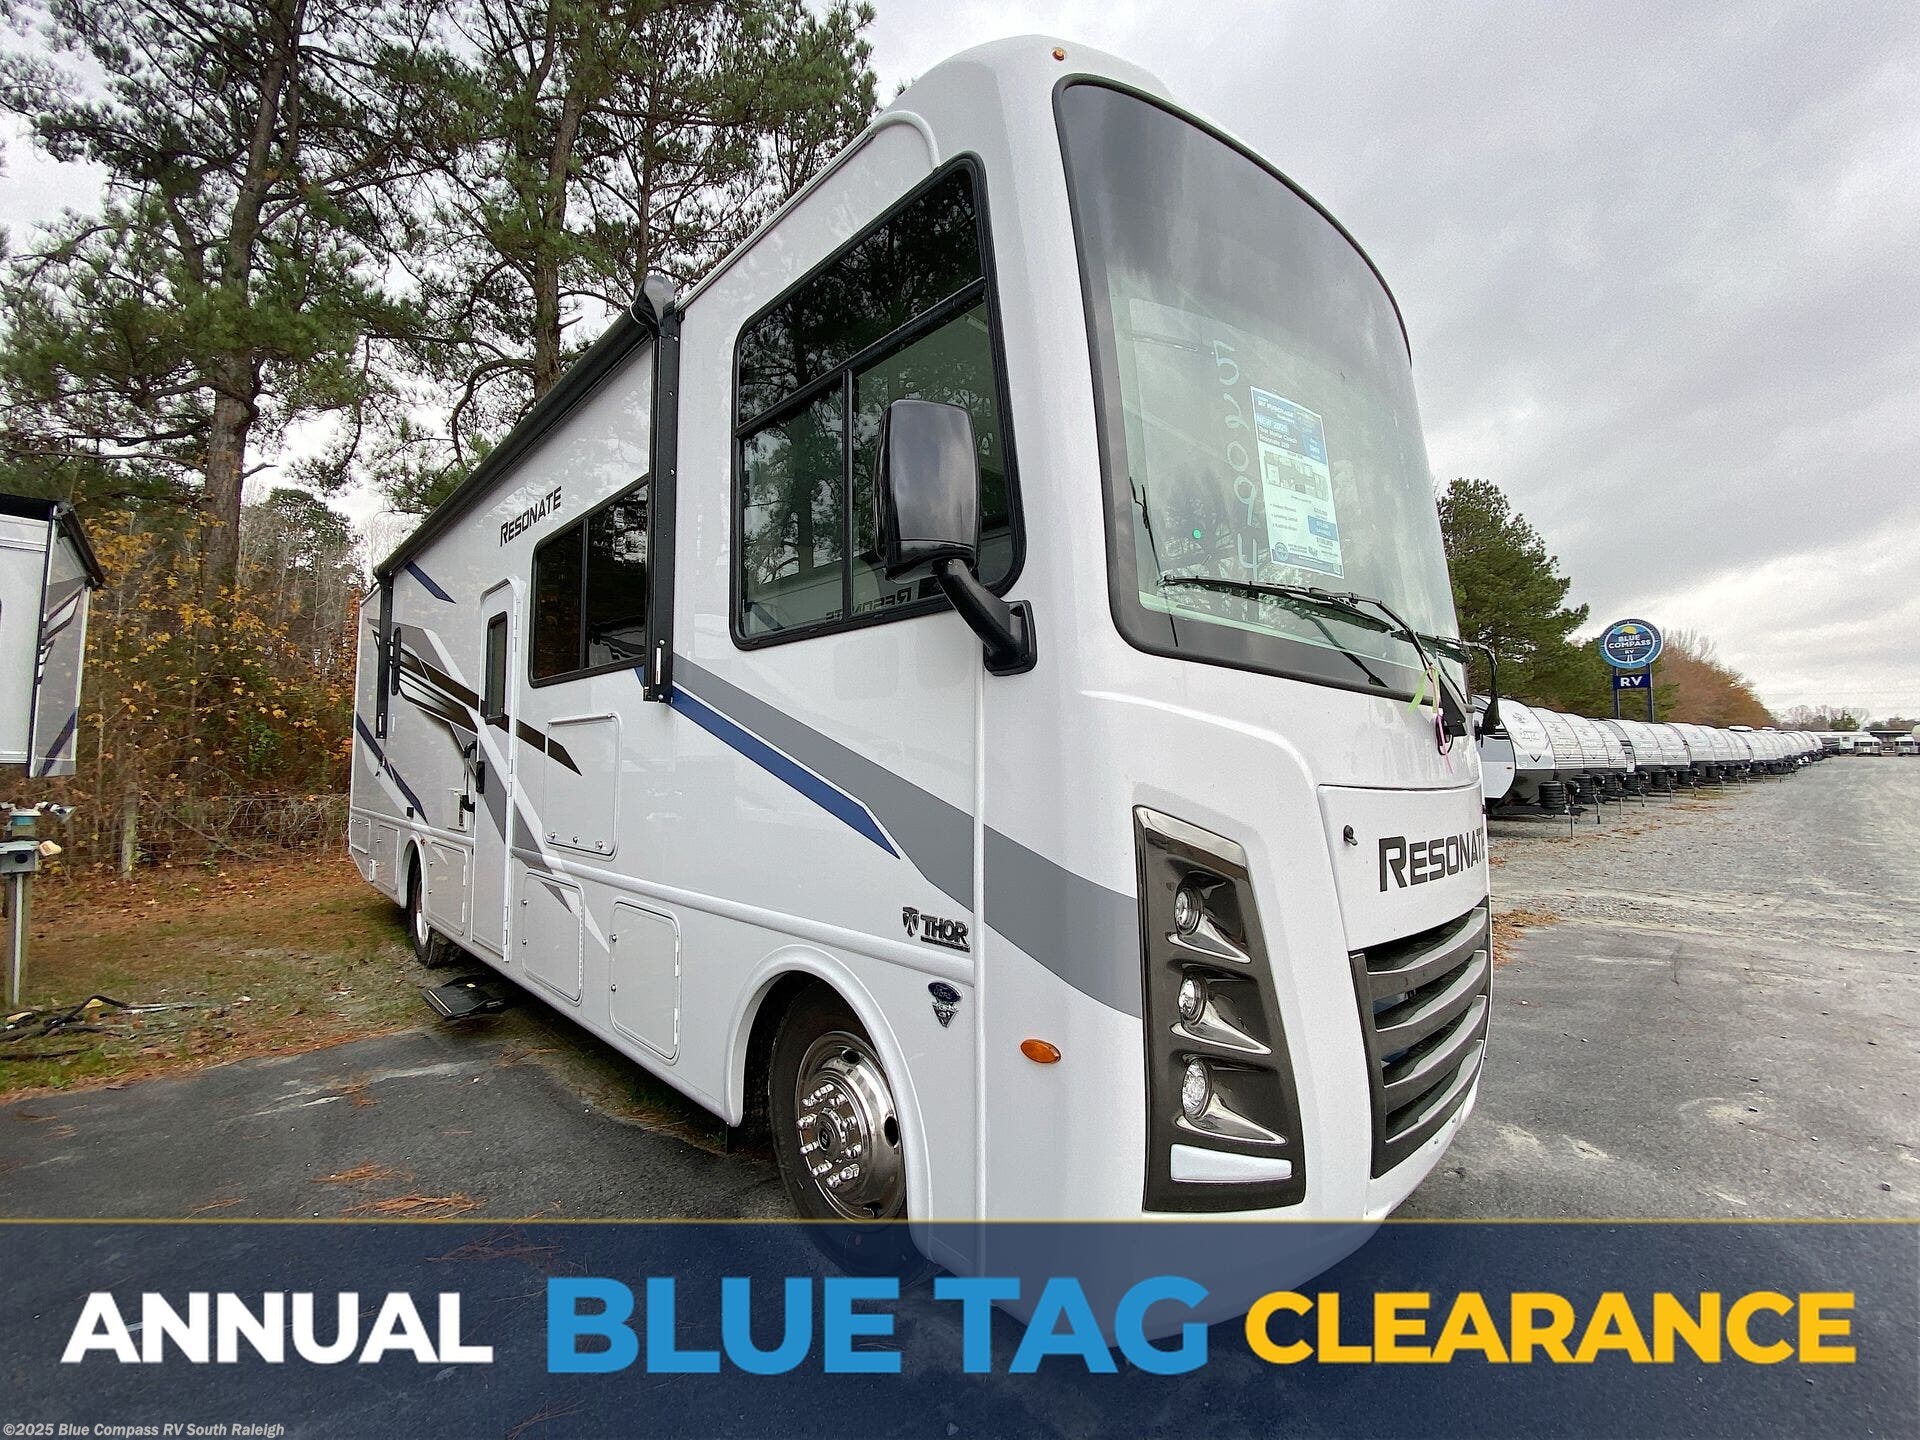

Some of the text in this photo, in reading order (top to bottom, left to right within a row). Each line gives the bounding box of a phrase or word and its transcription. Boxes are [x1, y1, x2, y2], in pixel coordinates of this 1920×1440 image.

[500, 486, 562, 547] RESONATE
[1618, 634, 1640, 642] BLUE
[1608, 640, 1651, 649] COMPASS
[1620, 676, 1643, 687] RV
[920, 914, 969, 947] THOR
